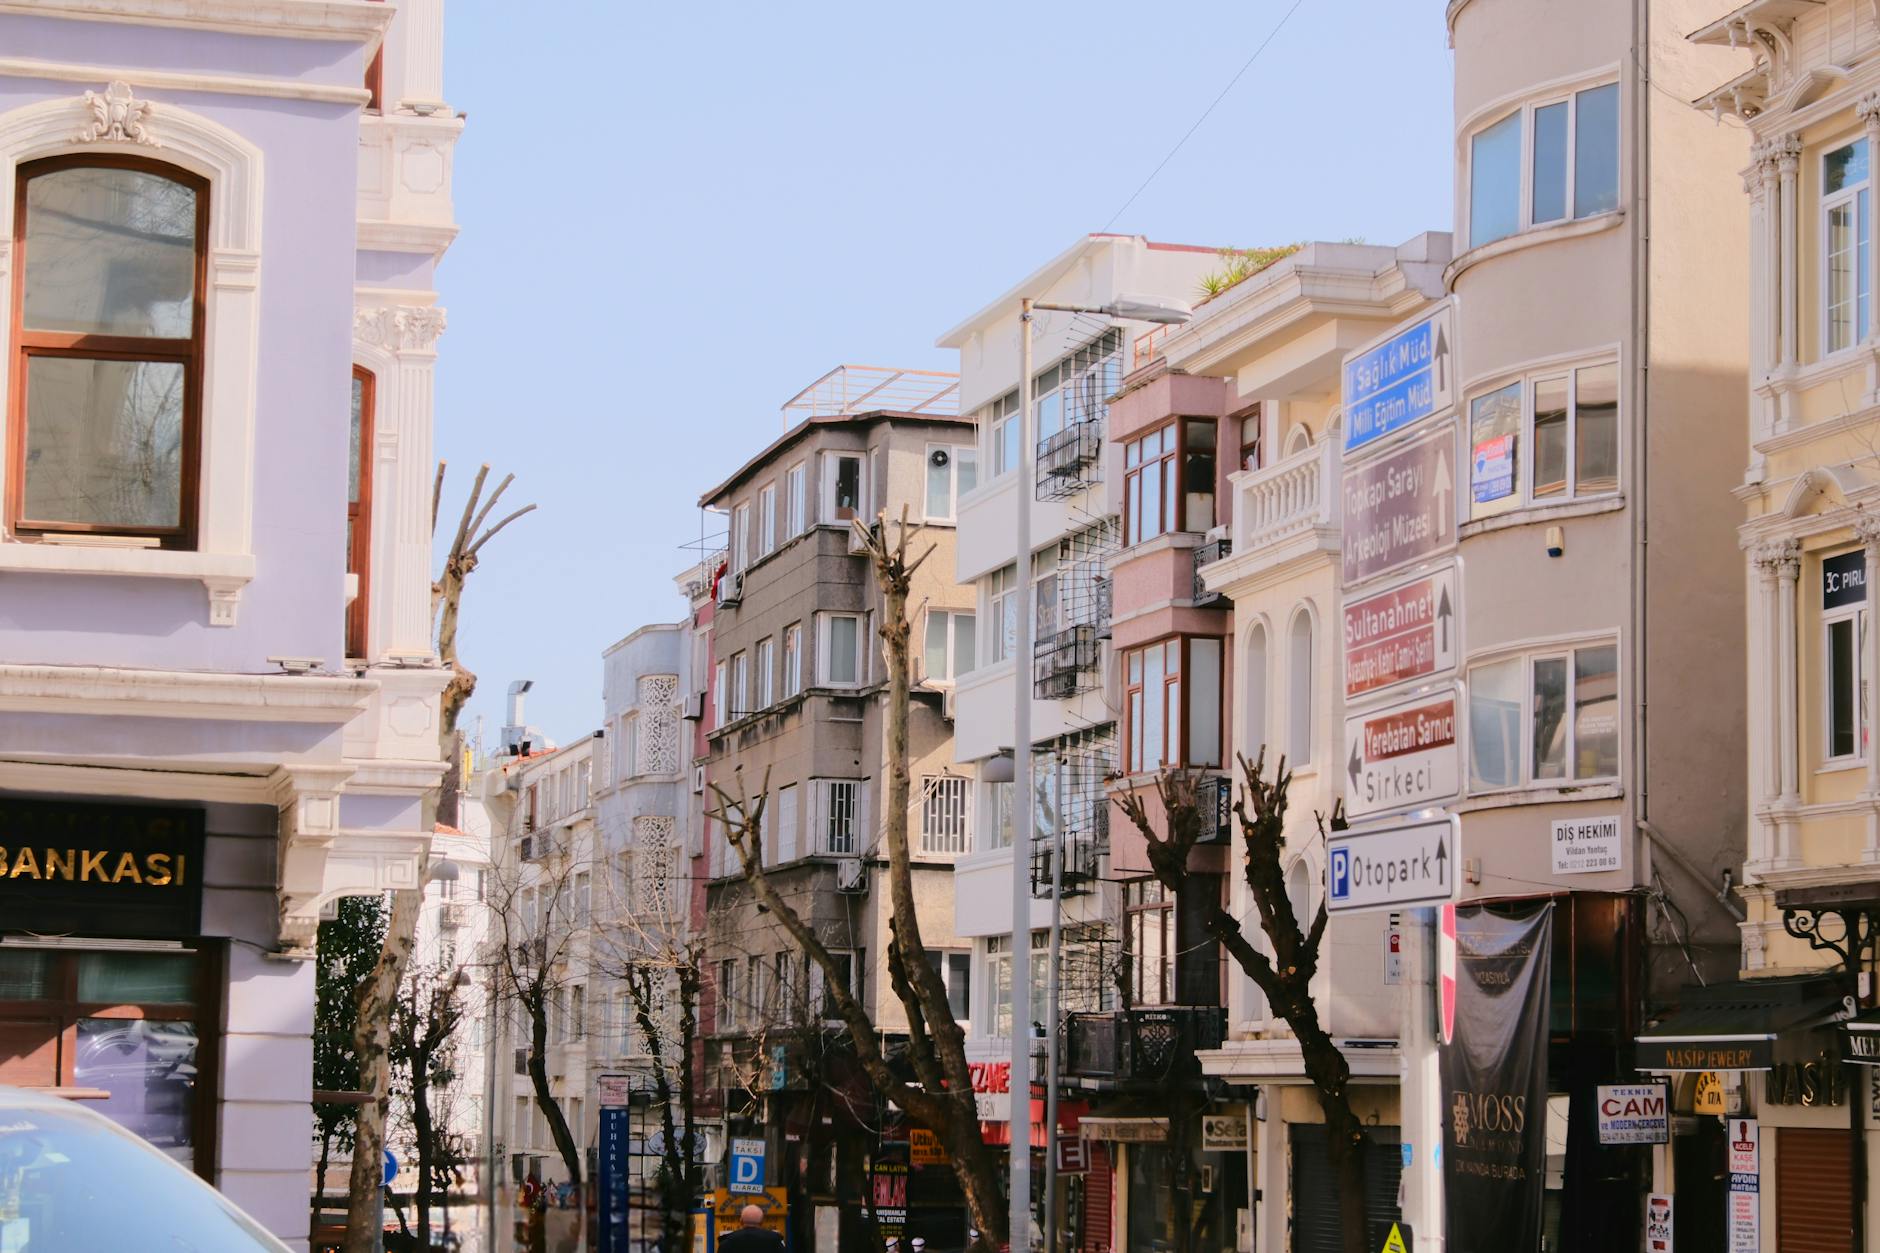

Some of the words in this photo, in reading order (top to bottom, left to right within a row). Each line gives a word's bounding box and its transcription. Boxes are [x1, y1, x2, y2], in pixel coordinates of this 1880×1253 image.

[1357, 351, 1396, 391] Sağlık
[1400, 332, 1430, 370] Müd.
[1375, 396, 1406, 432] Eğitim
[1345, 480, 1386, 520] Topkapı
[1388, 463, 1424, 498] Sarayı
[1345, 522, 1390, 567] Arkeoloji
[1346, 590, 1433, 643] Sultanahmet
[1366, 720, 1416, 756] Yerebatan
[1417, 713, 1454, 746] Sarnıcı
[1366, 760, 1432, 803] Sirkeci
[1557, 824, 1575, 845] DİŞ
[1578, 819, 1616, 840] HEKİMİ
[1334, 853, 1347, 895] P
[1353, 847, 1431, 893] Otopark
[1707, 1049, 1752, 1067] JEWELRY
[1469, 1091, 1526, 1133] MOSS
[1601, 1097, 1664, 1117] CAM
[1214, 1119, 1247, 1138] Sefa
[737, 1157, 757, 1183] D
